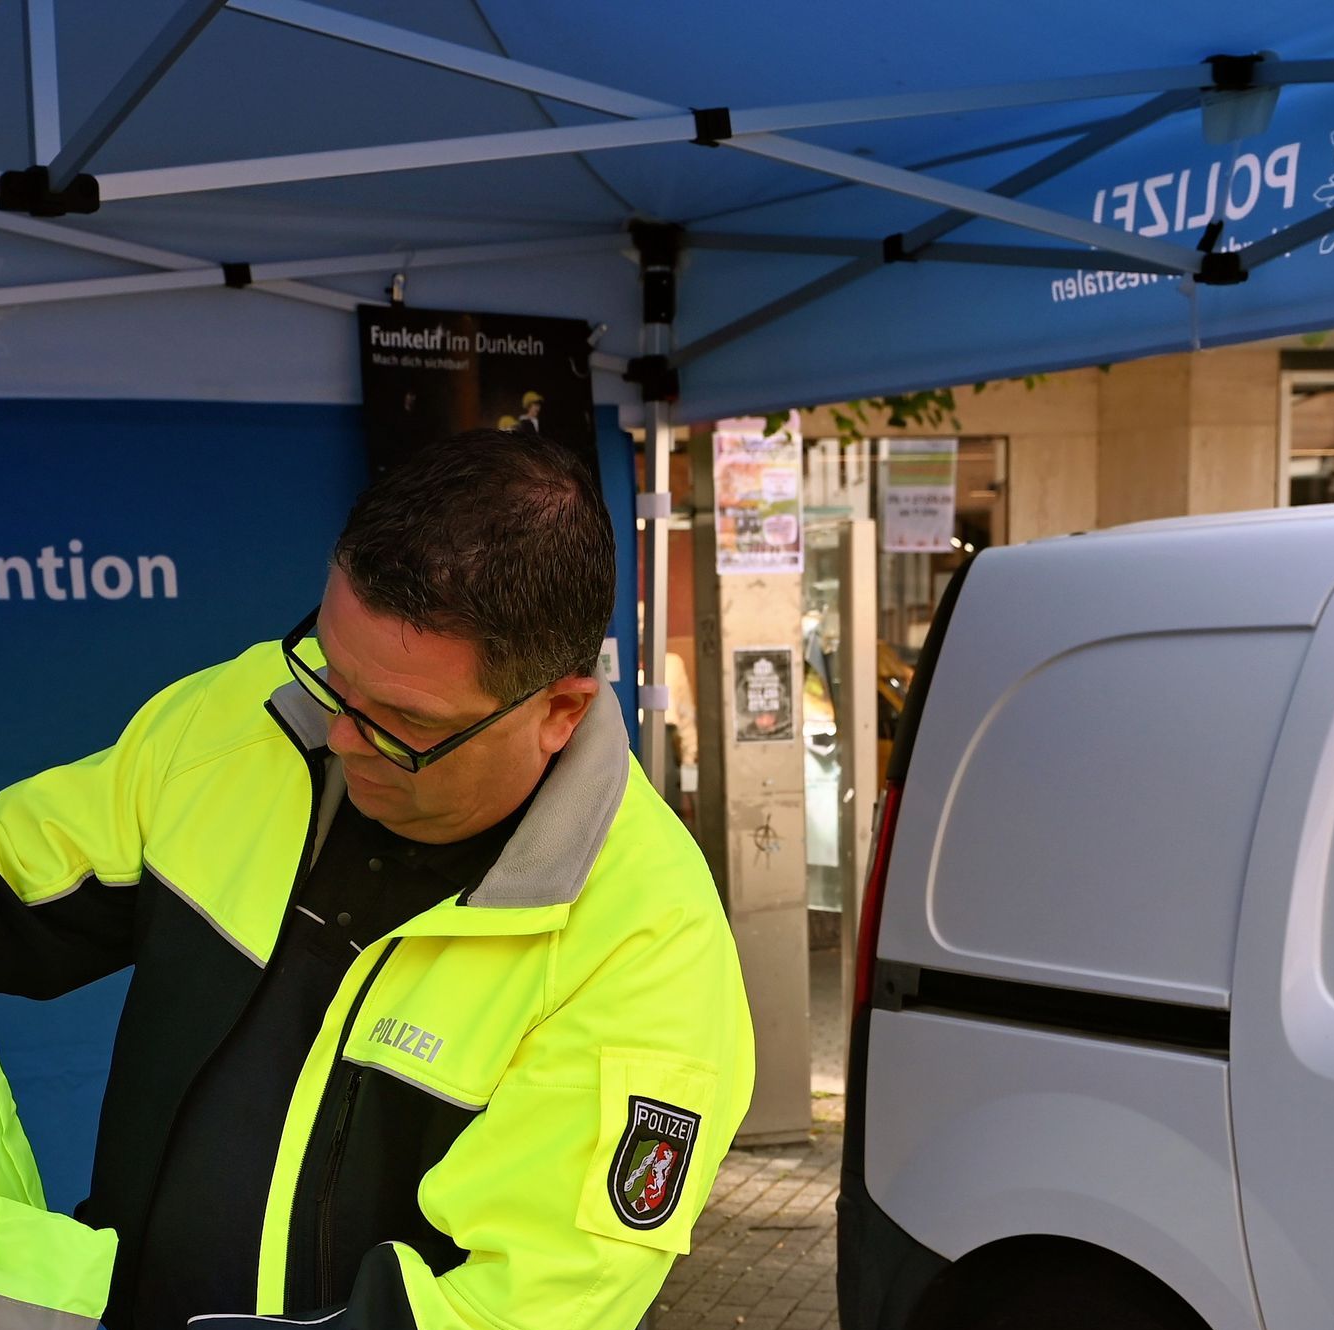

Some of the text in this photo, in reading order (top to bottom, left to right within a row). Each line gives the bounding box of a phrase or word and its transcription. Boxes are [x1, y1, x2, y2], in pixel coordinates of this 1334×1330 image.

[370, 325, 544, 356] Funkeln im Dunkeln
[372, 353, 470, 370] Mach dich sichtbar!
[369, 1016, 445, 1064] POLIZEI
[636, 1107, 694, 1142] POLIZEI
